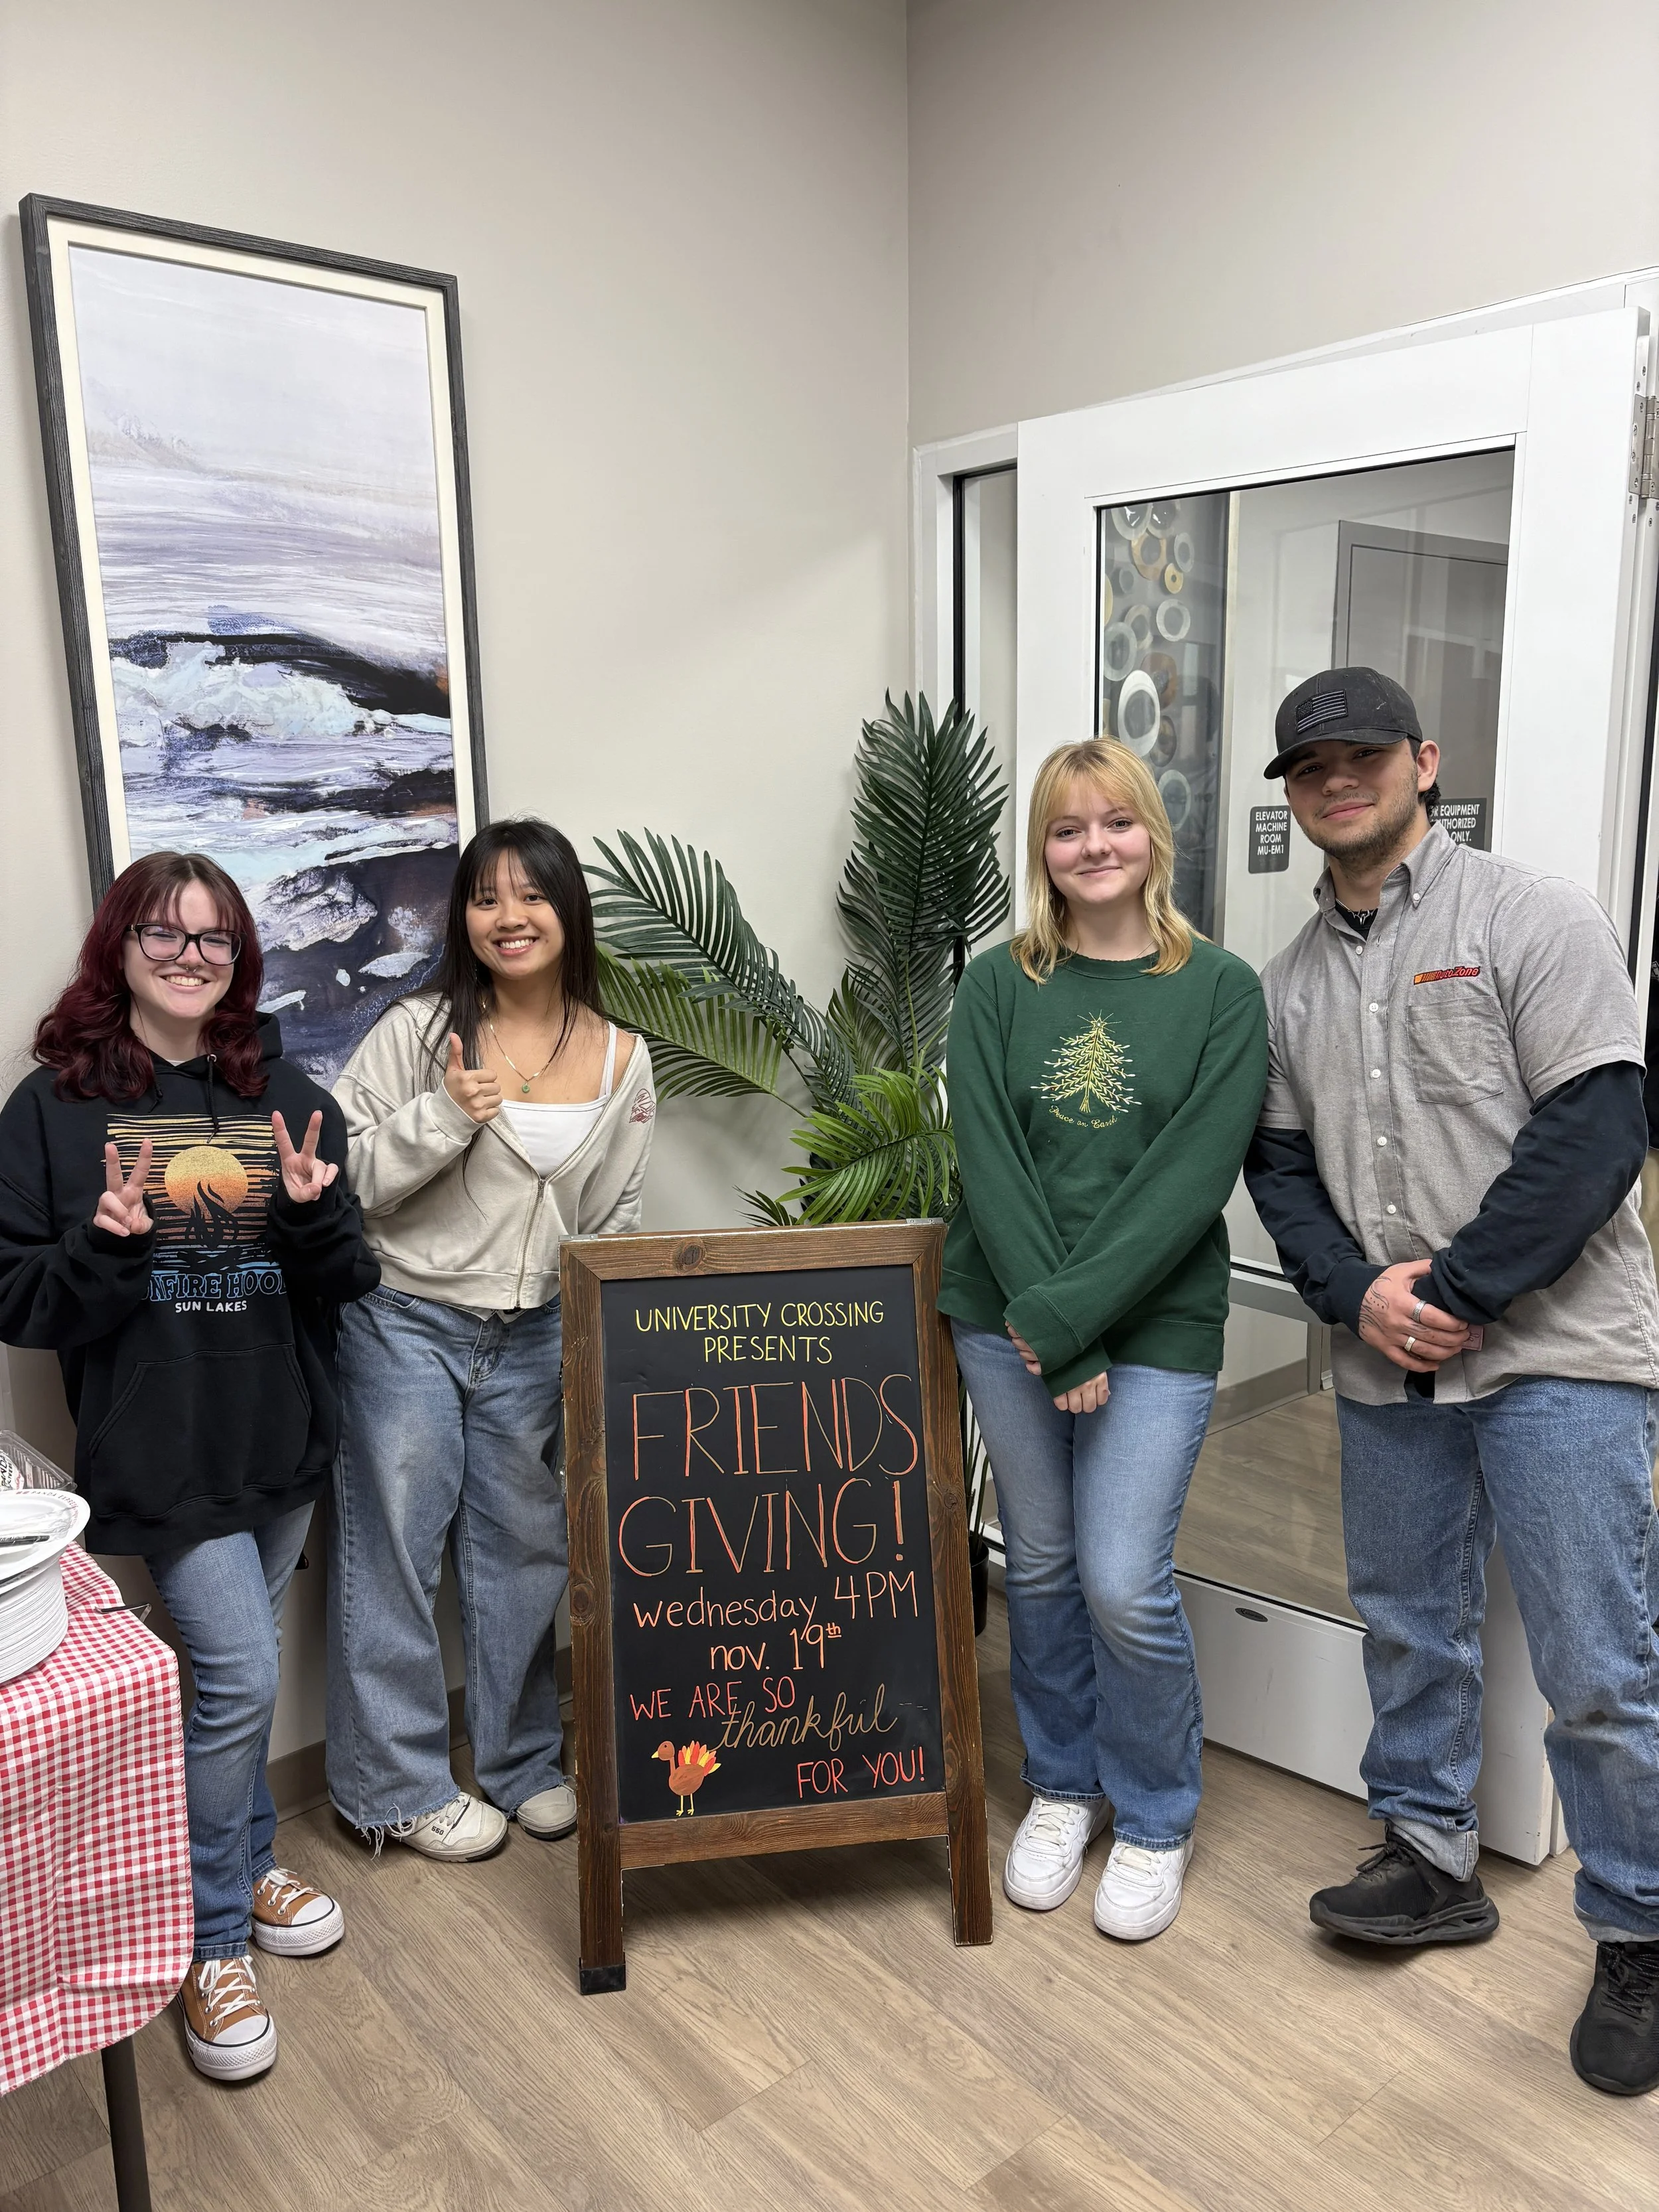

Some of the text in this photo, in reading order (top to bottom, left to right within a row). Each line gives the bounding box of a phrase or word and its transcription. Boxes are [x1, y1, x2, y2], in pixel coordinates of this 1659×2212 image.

[1256, 810, 1287, 821] ELEVATOR
[1440, 804, 1480, 816] EQUIPMENT
[1256, 822, 1287, 832] MACHINE
[1439, 817, 1476, 830] THORIZED
[1451, 830, 1472, 842] ONLY.
[1257, 844, 1284, 855] MU-EM1
[1260, 834, 1281, 844] ROOM
[1049, 1105, 1074, 1124] Peace
[1091, 1115, 1118, 1128] Earth
[141, 1273, 222, 1301] NFIRE
[175, 1299, 248, 1313] SUN LAKES
[635, 1301, 884, 1332] UNIVERSITY CROSSING
[704, 1335, 833, 1364] PRESENTS
[632, 1374, 919, 1481] FRIENDS
[618, 1478, 904, 1577] GIVING!
[633, 1570, 918, 1641] wednesday 4PM
[710, 1642, 770, 1671] nov.
[630, 1676, 796, 1721] WE ARE SO
[708, 1683, 898, 1752] thankful
[797, 1746, 926, 1799] FOR YOU!
[431, 1826, 444, 1835] 550
